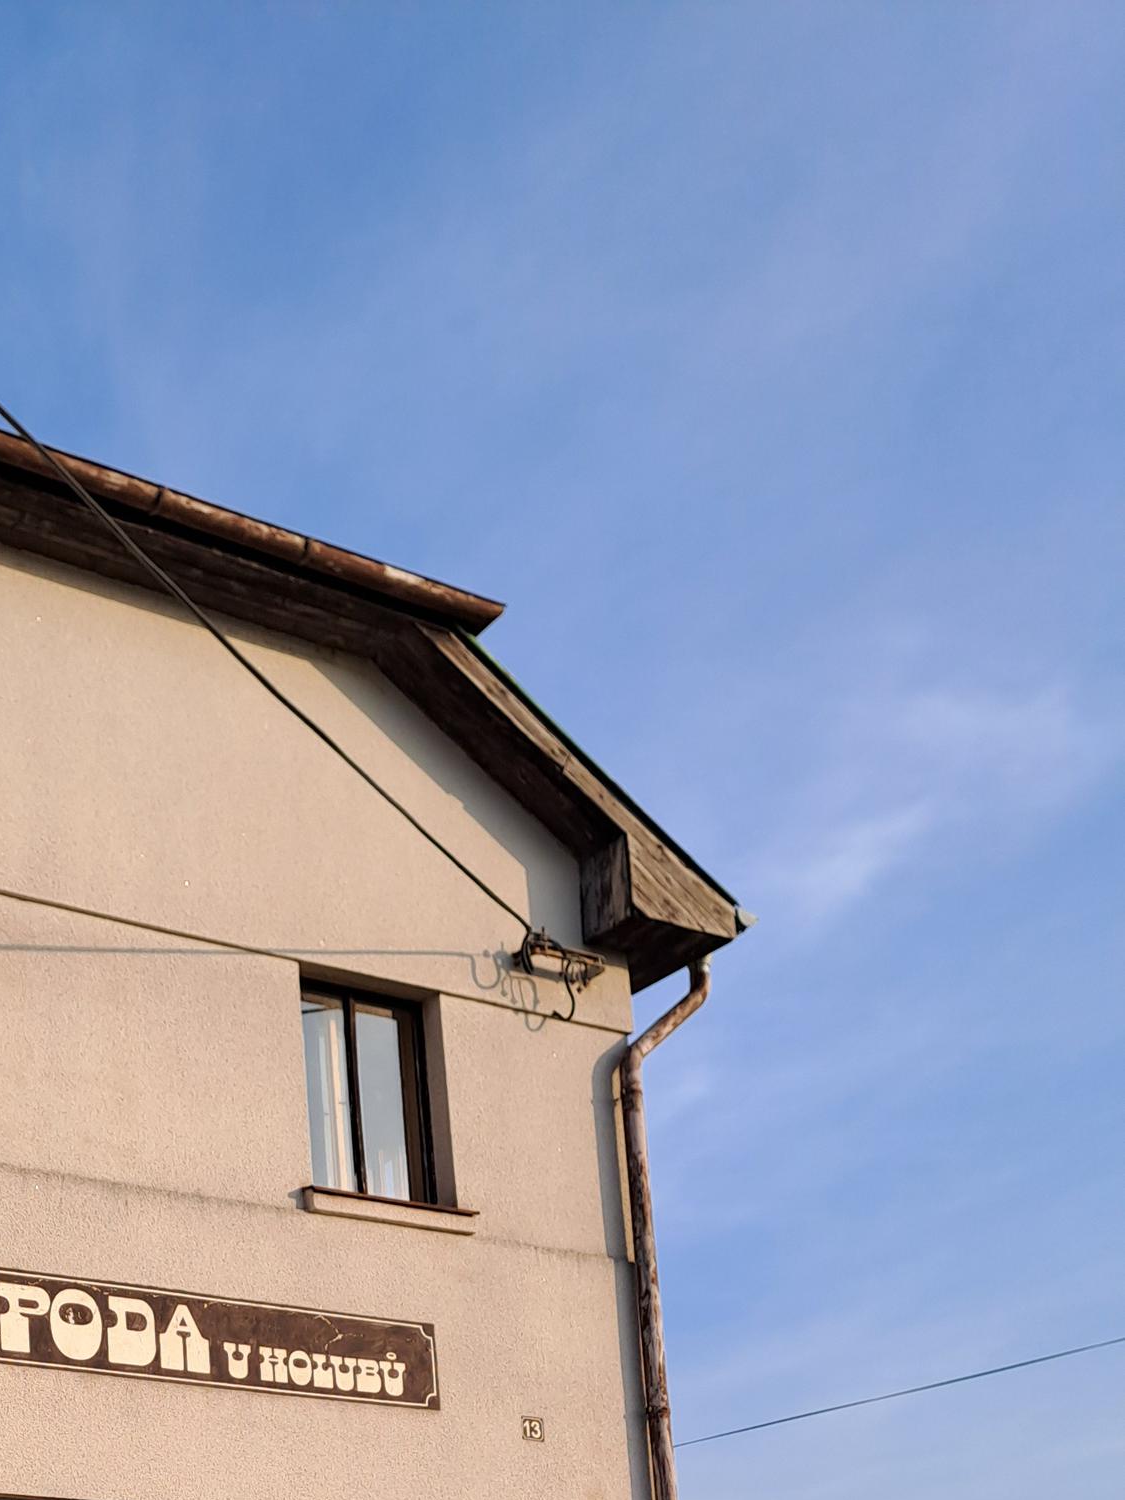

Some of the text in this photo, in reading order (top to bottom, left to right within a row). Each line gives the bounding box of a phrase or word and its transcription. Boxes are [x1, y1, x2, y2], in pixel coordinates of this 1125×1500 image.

[223, 1341, 252, 1380] U
[258, 1345, 407, 1397] HOLUBŮ
[523, 1420, 541, 1438] 13
